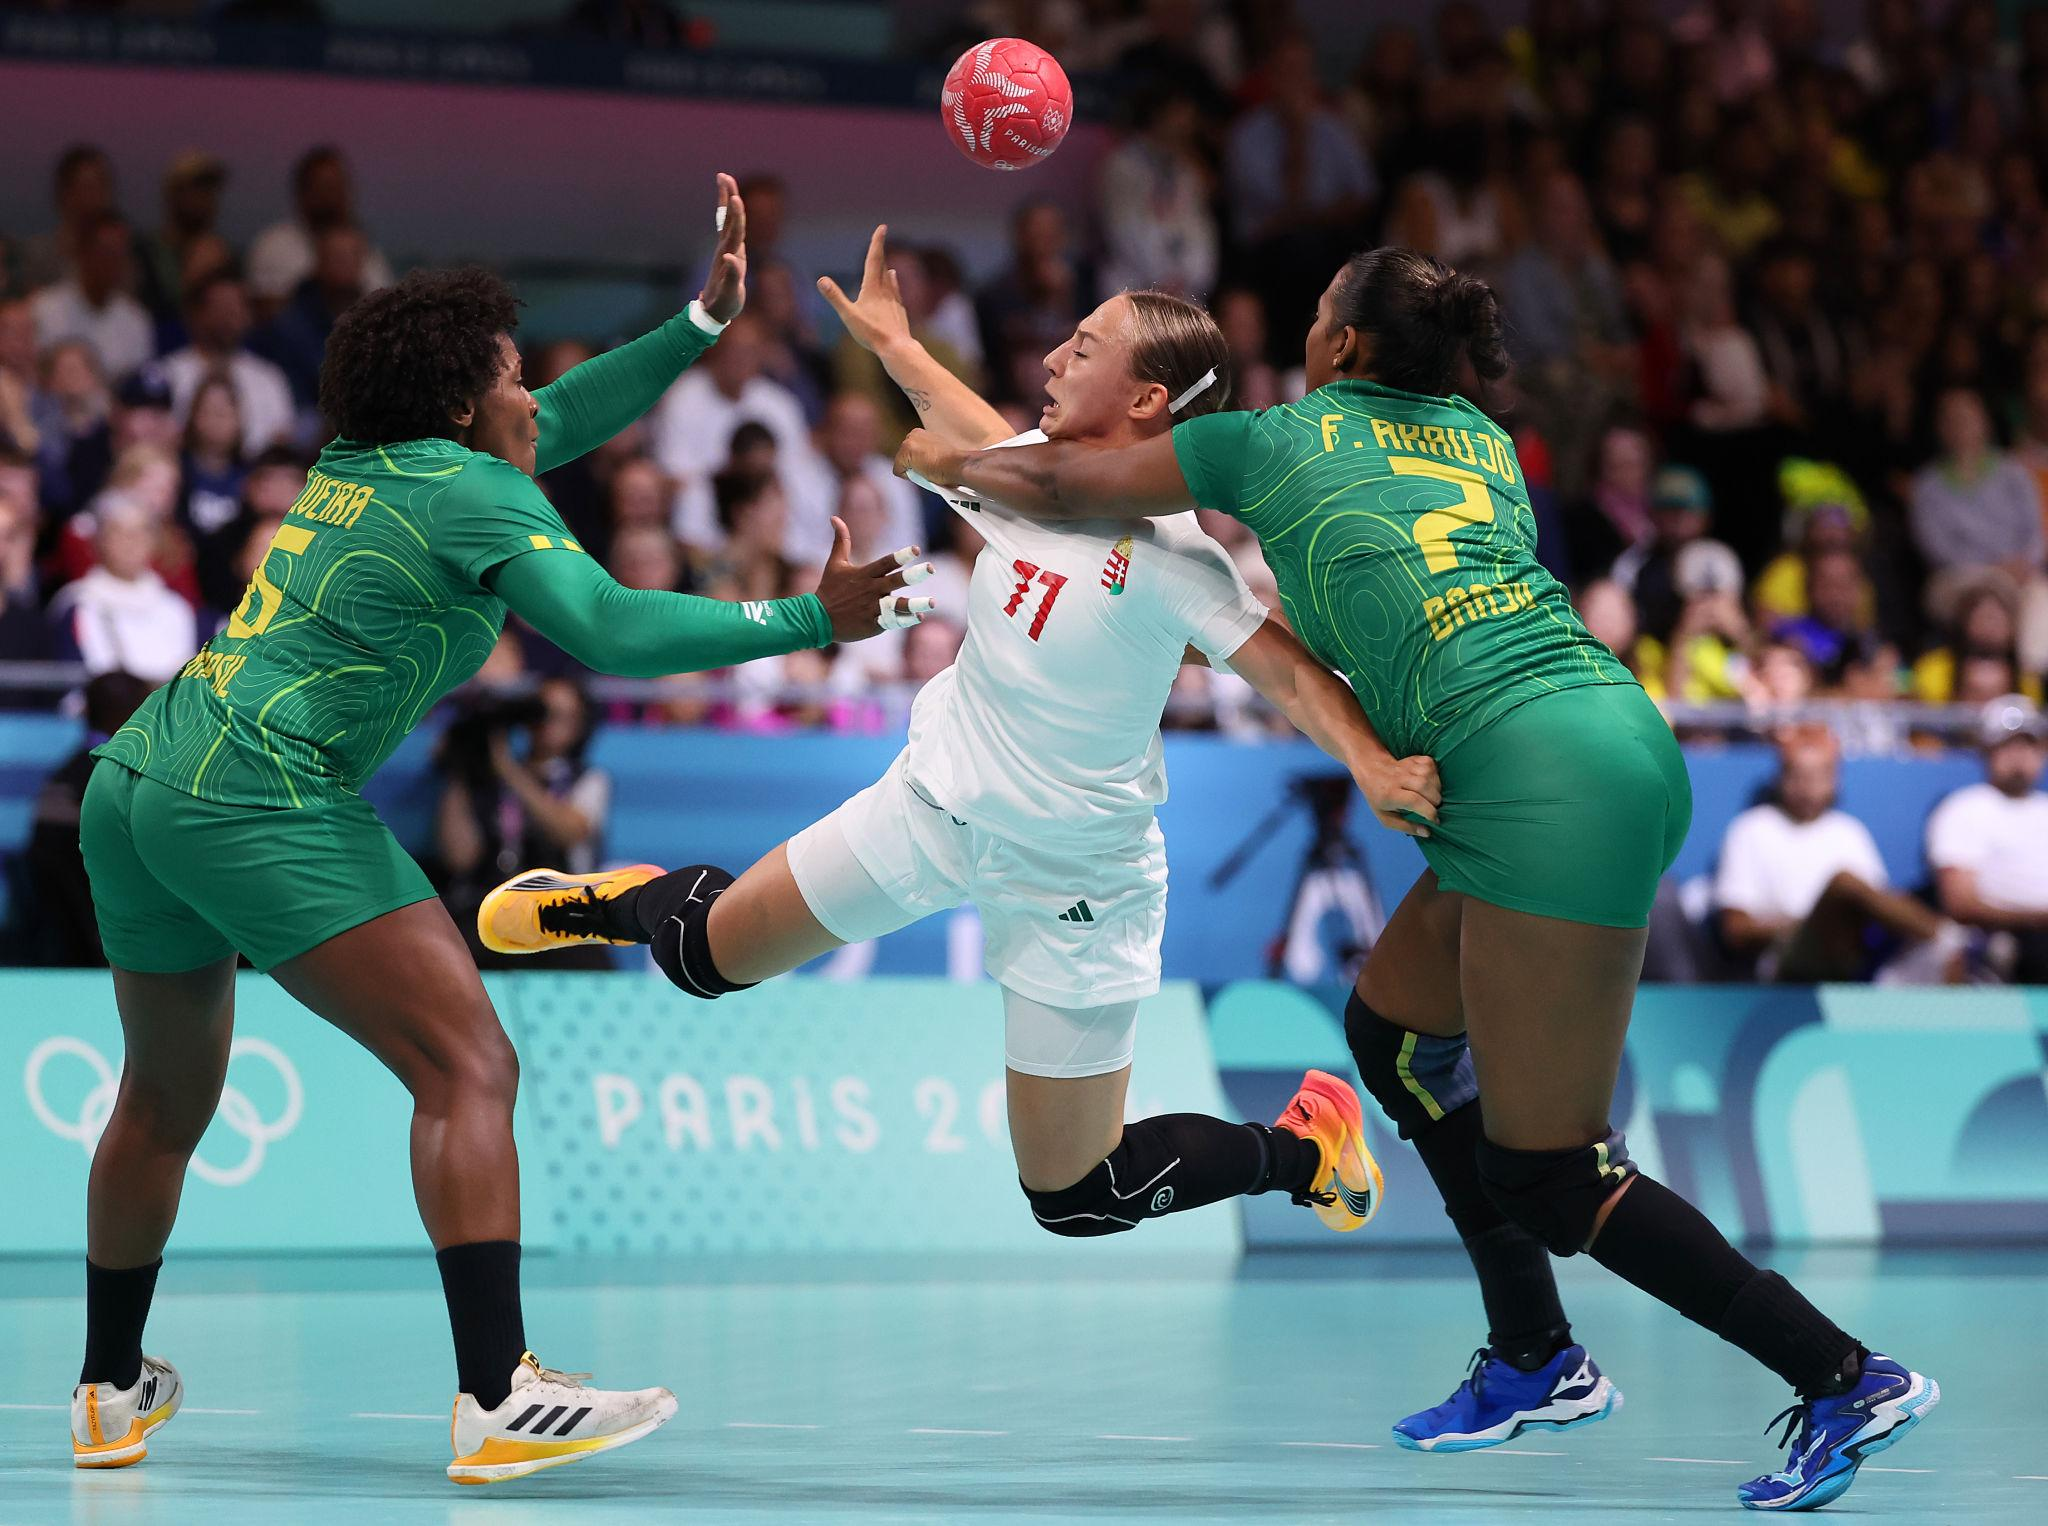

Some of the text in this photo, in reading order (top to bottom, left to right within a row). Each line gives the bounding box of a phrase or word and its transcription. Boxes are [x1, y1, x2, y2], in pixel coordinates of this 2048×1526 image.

[1320, 413, 1516, 486] F. ARAUJO
[288, 466, 376, 530] UEIRA
[1386, 455, 1496, 575] 2
[593, 1073, 881, 1153] PARIS
